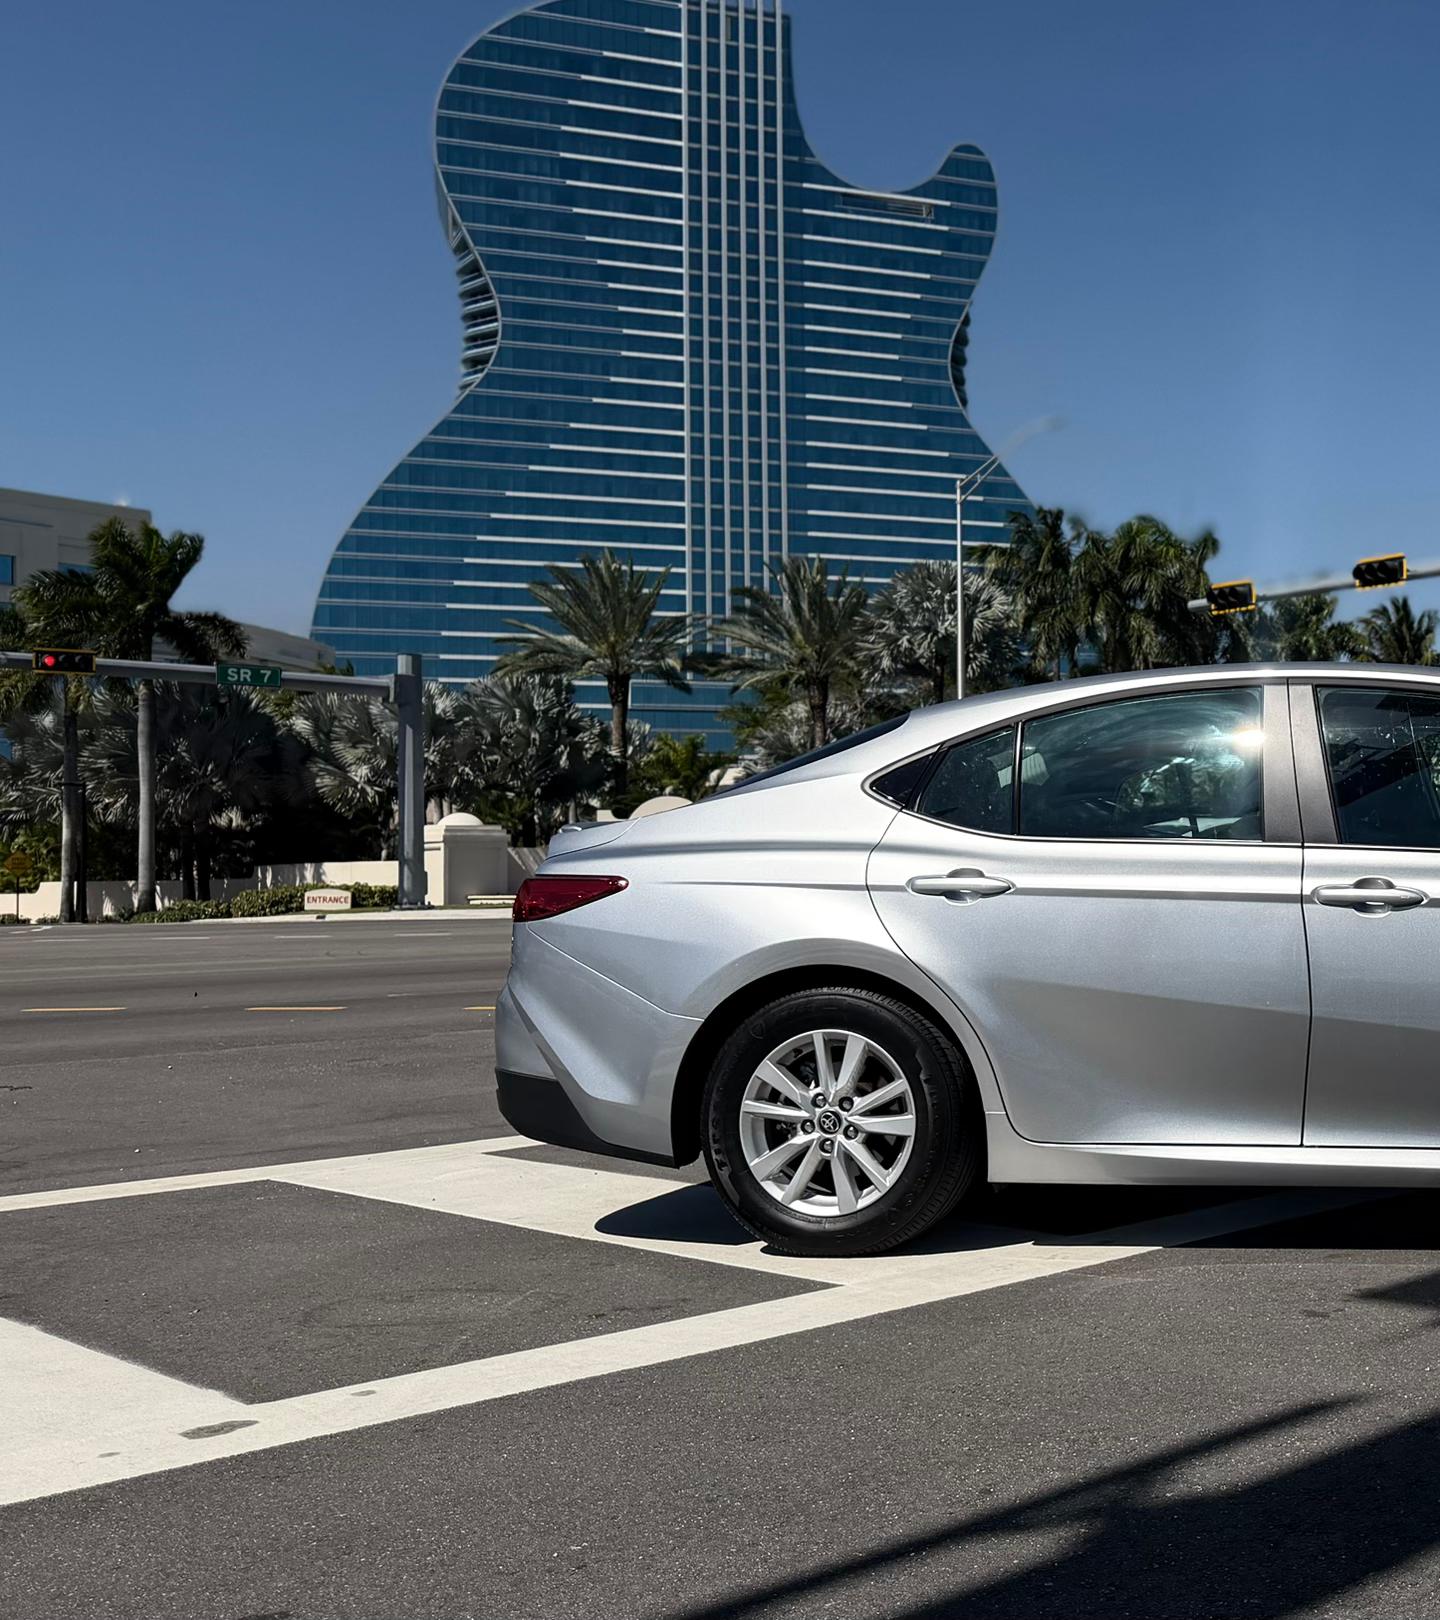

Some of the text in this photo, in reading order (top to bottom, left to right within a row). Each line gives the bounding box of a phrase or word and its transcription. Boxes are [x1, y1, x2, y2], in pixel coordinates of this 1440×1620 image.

[227, 667, 272, 683] SR 7
[306, 895, 350, 904] ENTRANCE
